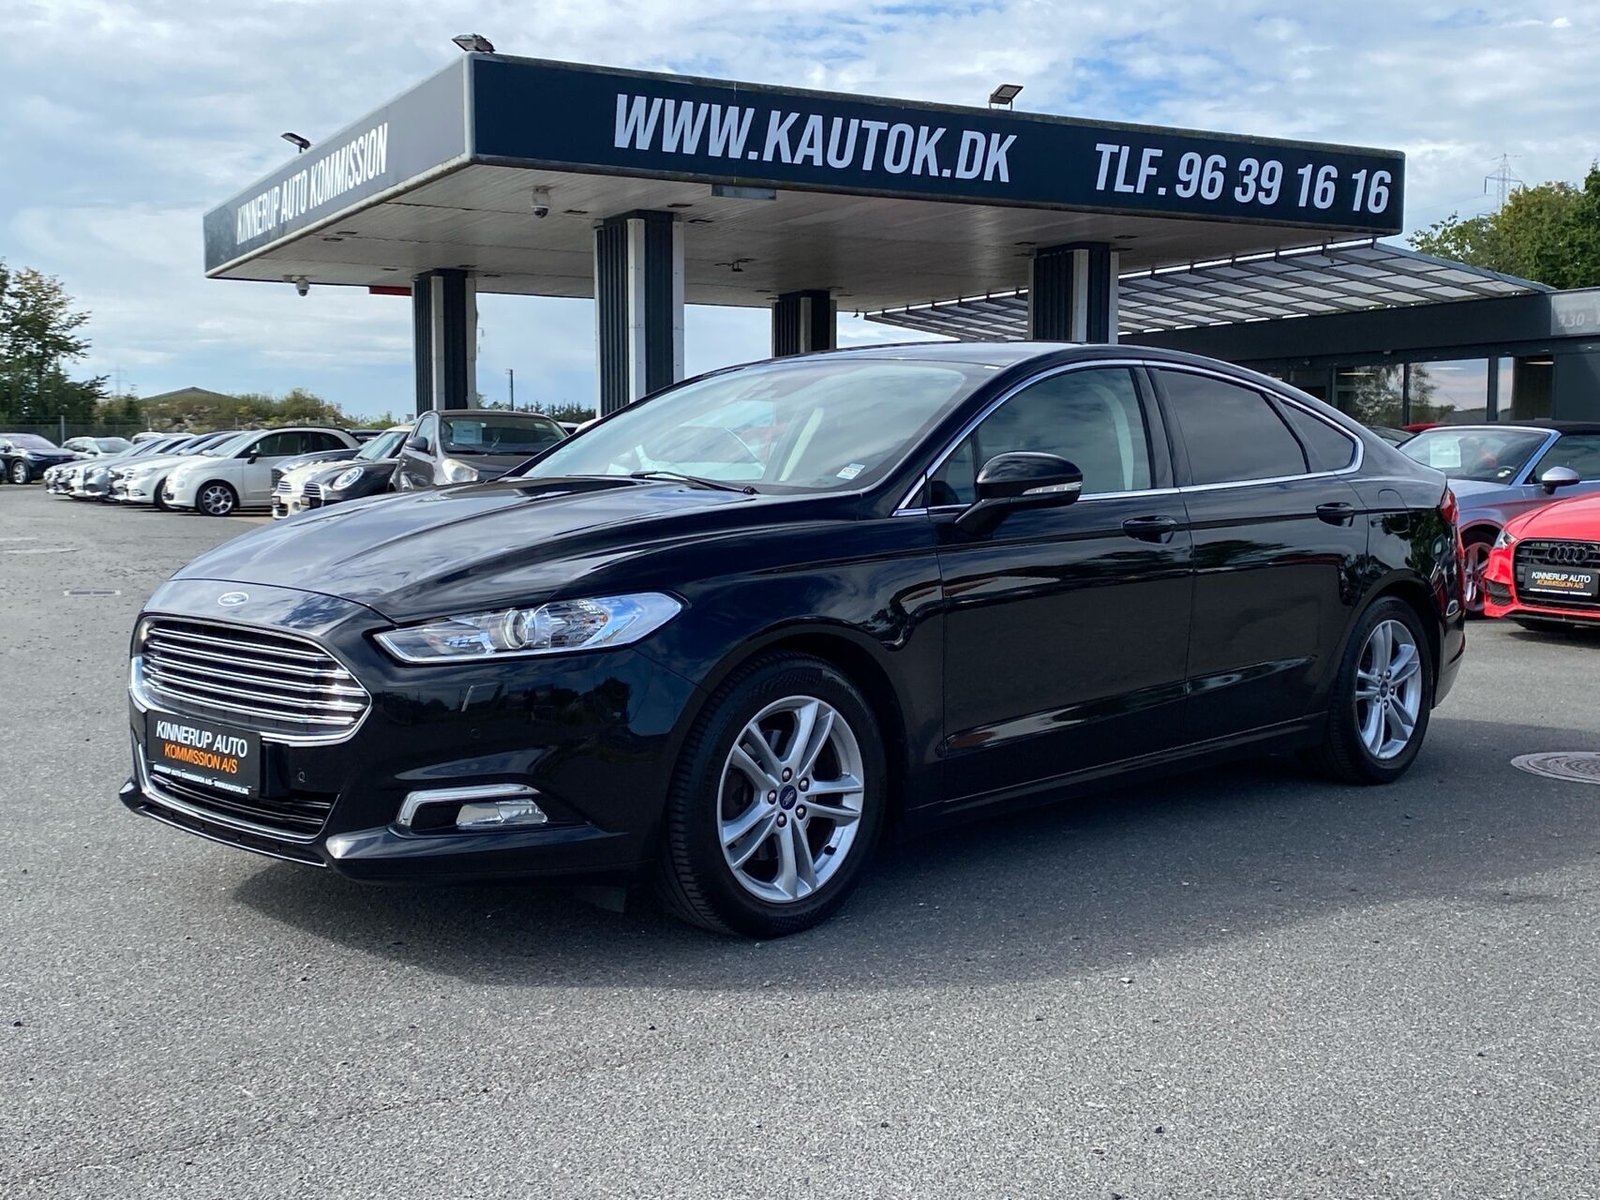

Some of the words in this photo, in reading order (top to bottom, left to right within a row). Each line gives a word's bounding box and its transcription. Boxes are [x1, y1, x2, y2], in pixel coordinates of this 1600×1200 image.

[613, 93, 1017, 183] WWW.KAUTOK.DK
[1095, 143, 1166, 196] TLF.
[1175, 151, 1227, 201] 96
[1234, 157, 1284, 206] 39
[1297, 163, 1338, 210] 16
[1351, 169, 1392, 214] 16
[236, 186, 280, 246] KINNERUP
[280, 169, 308, 224] AUTO
[309, 122, 388, 210] KOMMISSION
[1532, 571, 1568, 580] KINNERUP
[1569, 575, 1591, 583] AUTO
[156, 721, 212, 748] KINNERUP
[212, 734, 248, 758] AUTO
[165, 743, 220, 769] KOMMISSION
[221, 758, 237, 773] A/S
